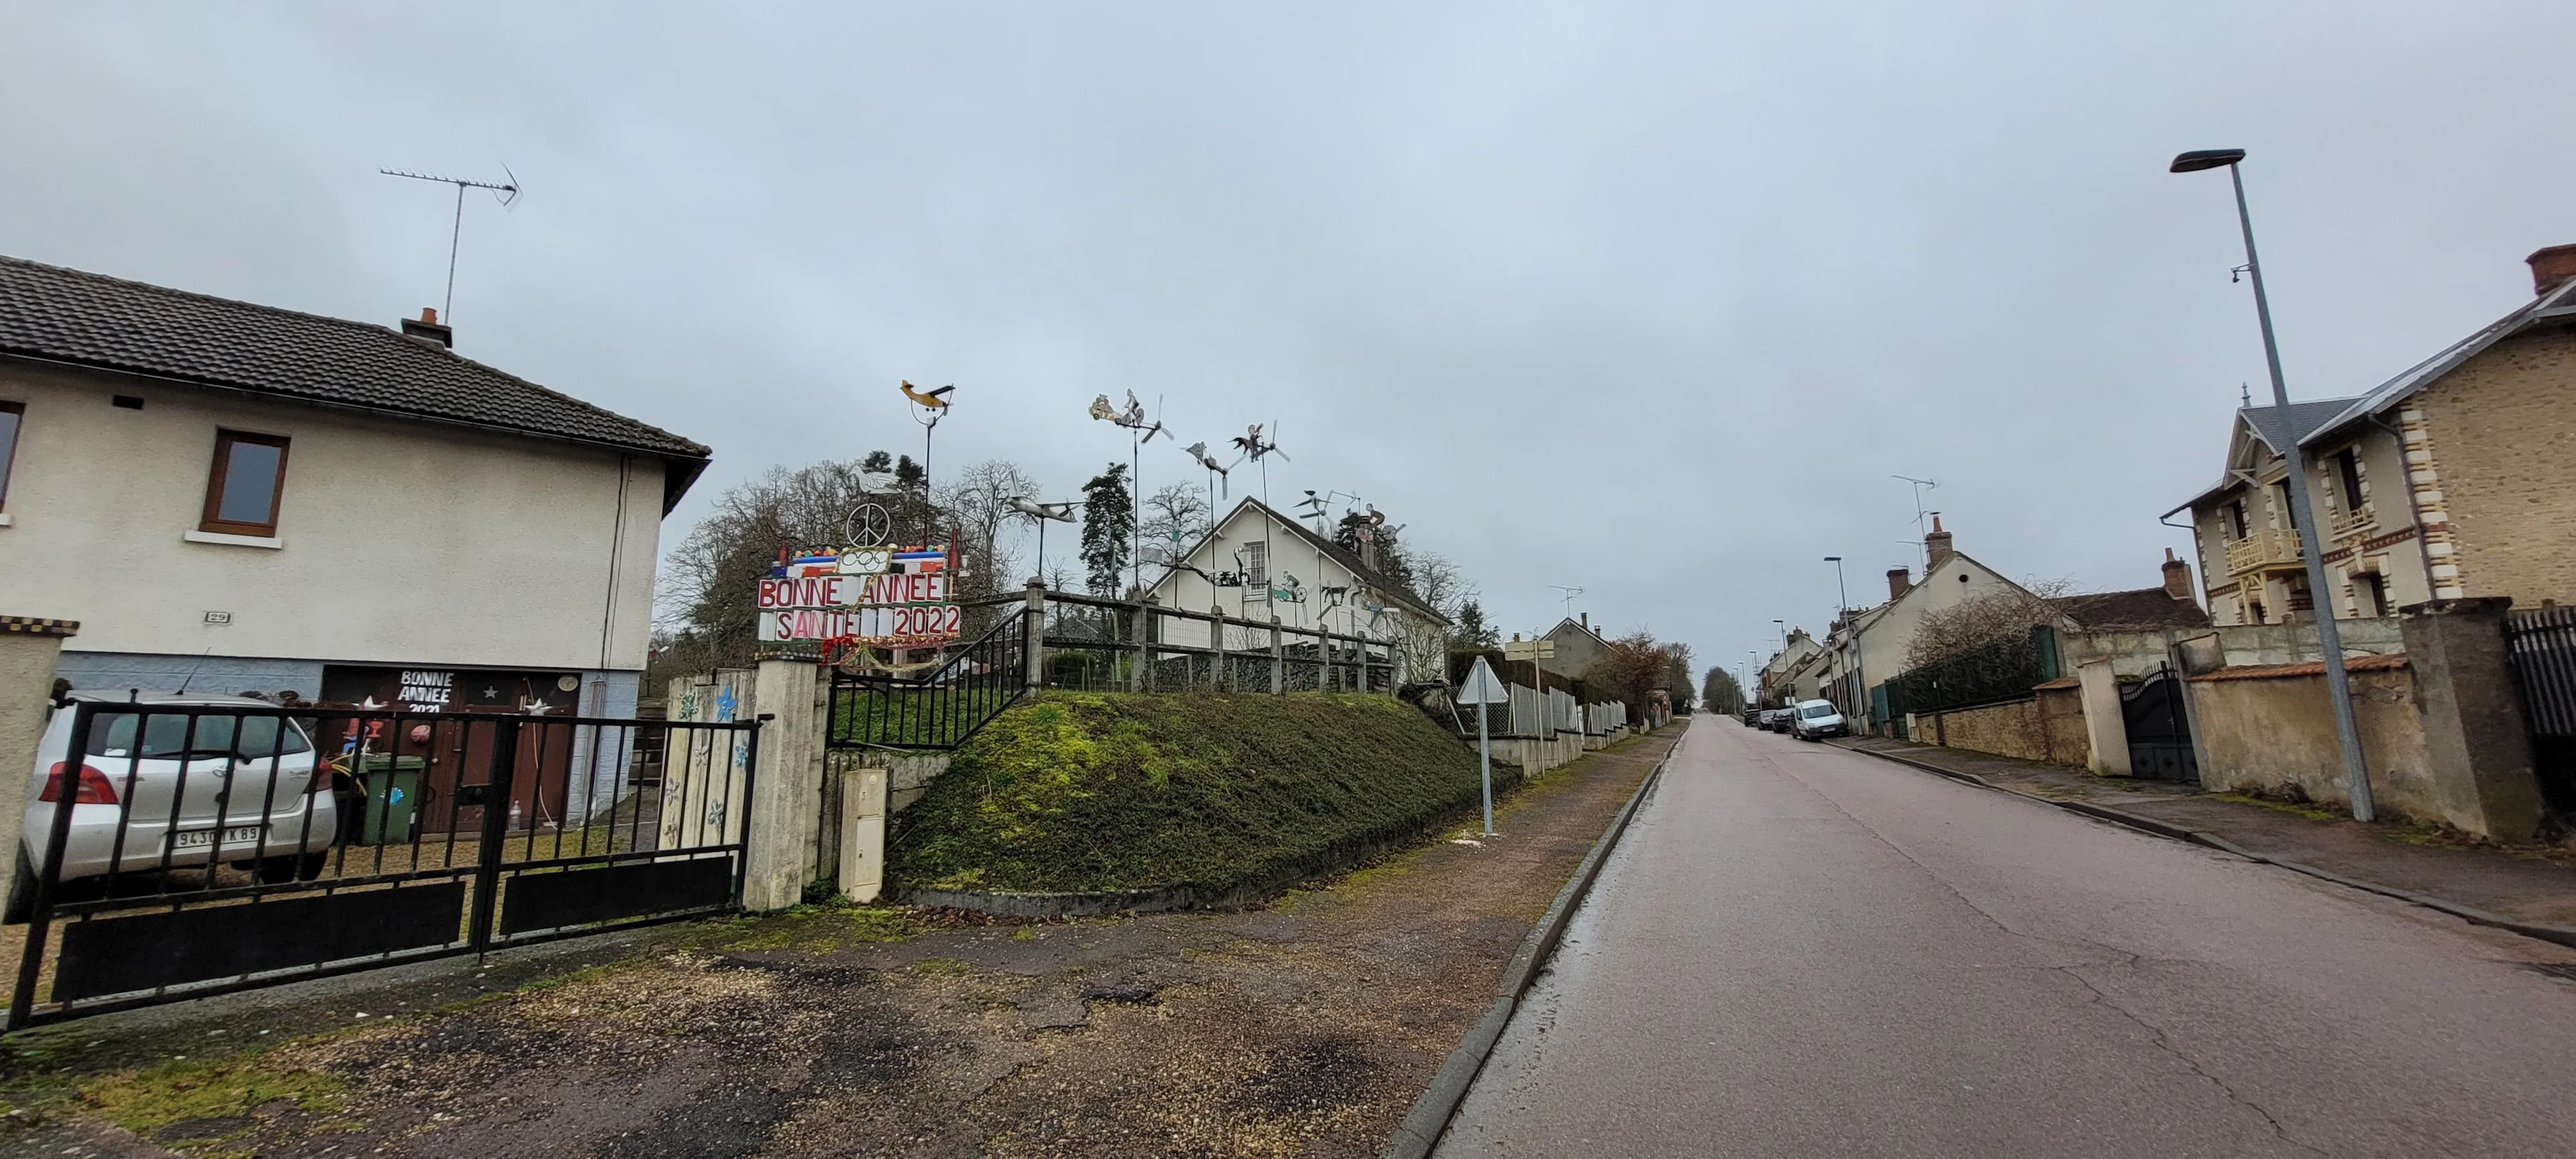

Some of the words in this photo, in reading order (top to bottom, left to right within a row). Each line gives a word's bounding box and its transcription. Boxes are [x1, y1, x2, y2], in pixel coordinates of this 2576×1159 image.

[759, 577, 843, 607] BONNE
[861, 573, 943, 603] ANNEE
[777, 610, 859, 640] SANTE
[895, 606, 959, 636] 2022
[400, 671, 454, 687] BONNE
[397, 685, 451, 703] ANNEE
[409, 704, 439, 713] 2021
[241, 828, 256, 840] 89
